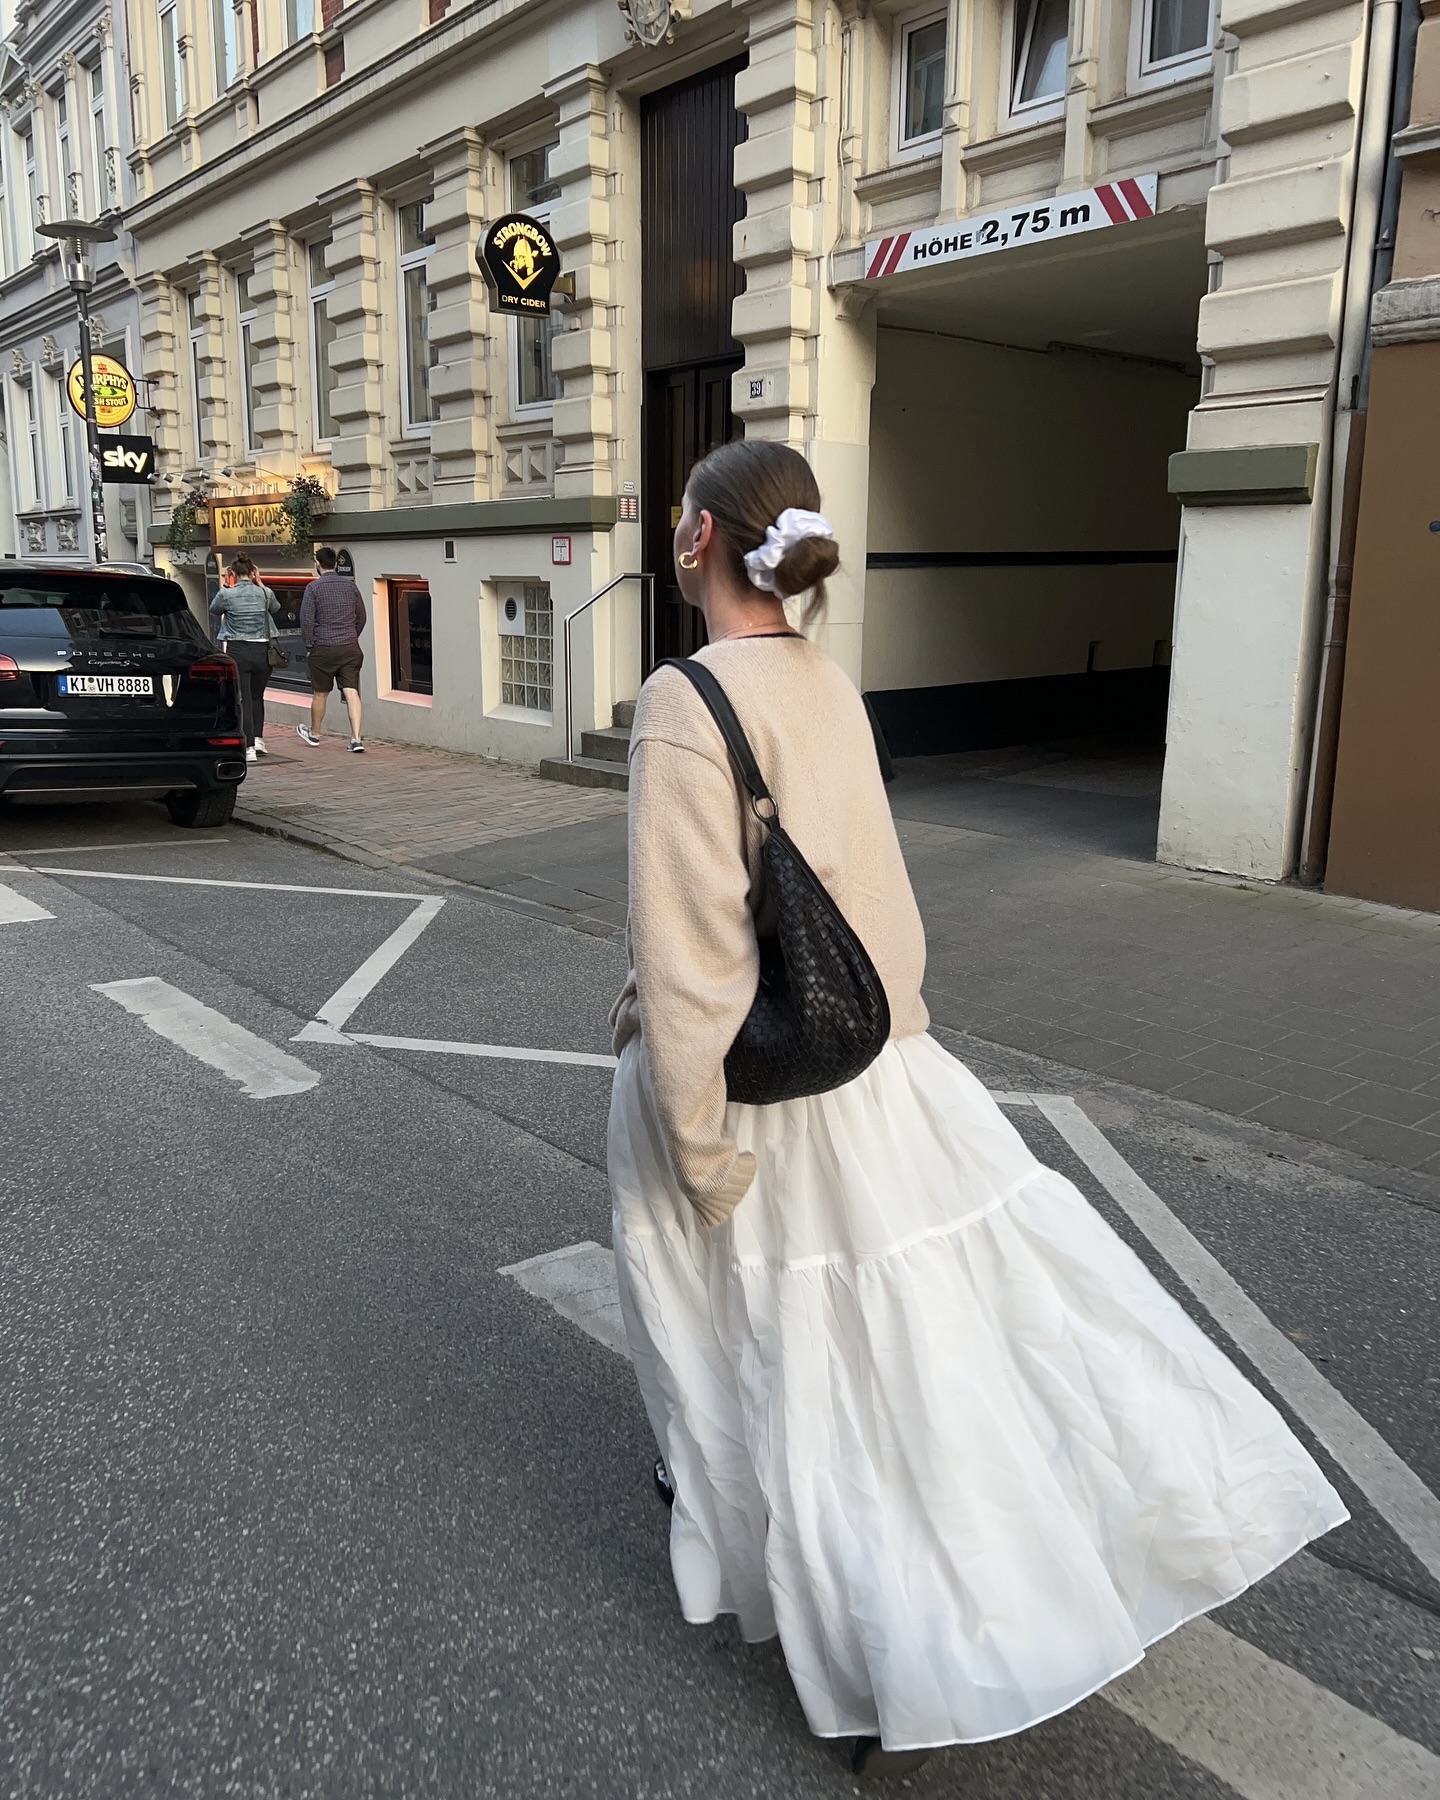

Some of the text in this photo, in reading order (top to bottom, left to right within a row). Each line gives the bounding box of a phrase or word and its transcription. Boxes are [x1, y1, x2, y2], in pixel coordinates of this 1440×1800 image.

[913, 203, 1091, 260] HÖHE 2,75 m
[493, 222, 552, 256] STRONGBOW
[501, 294, 546, 308] DRY CIDER
[751, 382, 761, 395] 39
[105, 397, 127, 406] STOUT
[103, 445, 148, 473] sky
[57, 650, 155, 658] PORSCHE
[70, 677, 150, 692] KI VH 8888
